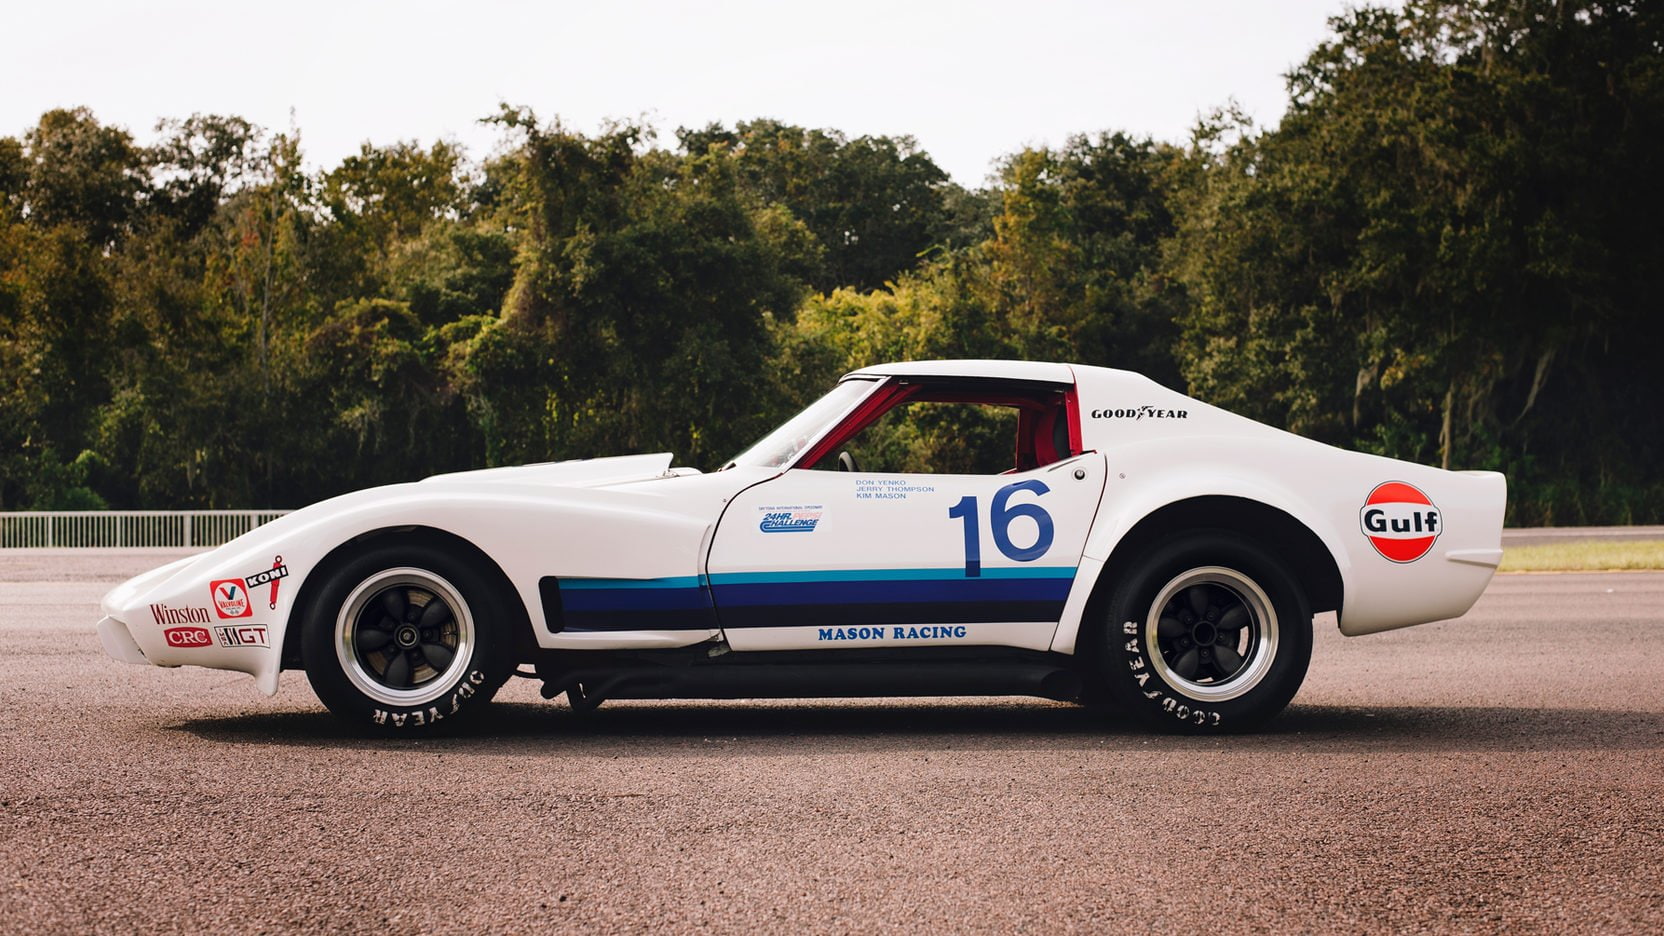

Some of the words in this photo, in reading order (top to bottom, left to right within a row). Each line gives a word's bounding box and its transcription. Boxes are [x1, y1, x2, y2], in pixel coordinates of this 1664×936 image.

[1091, 405, 1188, 420] GOODYEAR
[760, 519, 819, 533] CHALLENGE
[948, 479, 1055, 578] 16
[1364, 509, 1438, 533] Gulf
[247, 566, 287, 587] KONI
[150, 603, 212, 625] Winston
[168, 630, 208, 644] CRC
[239, 628, 266, 644] GT
[818, 628, 885, 641] MASON
[893, 626, 967, 640] RACING
